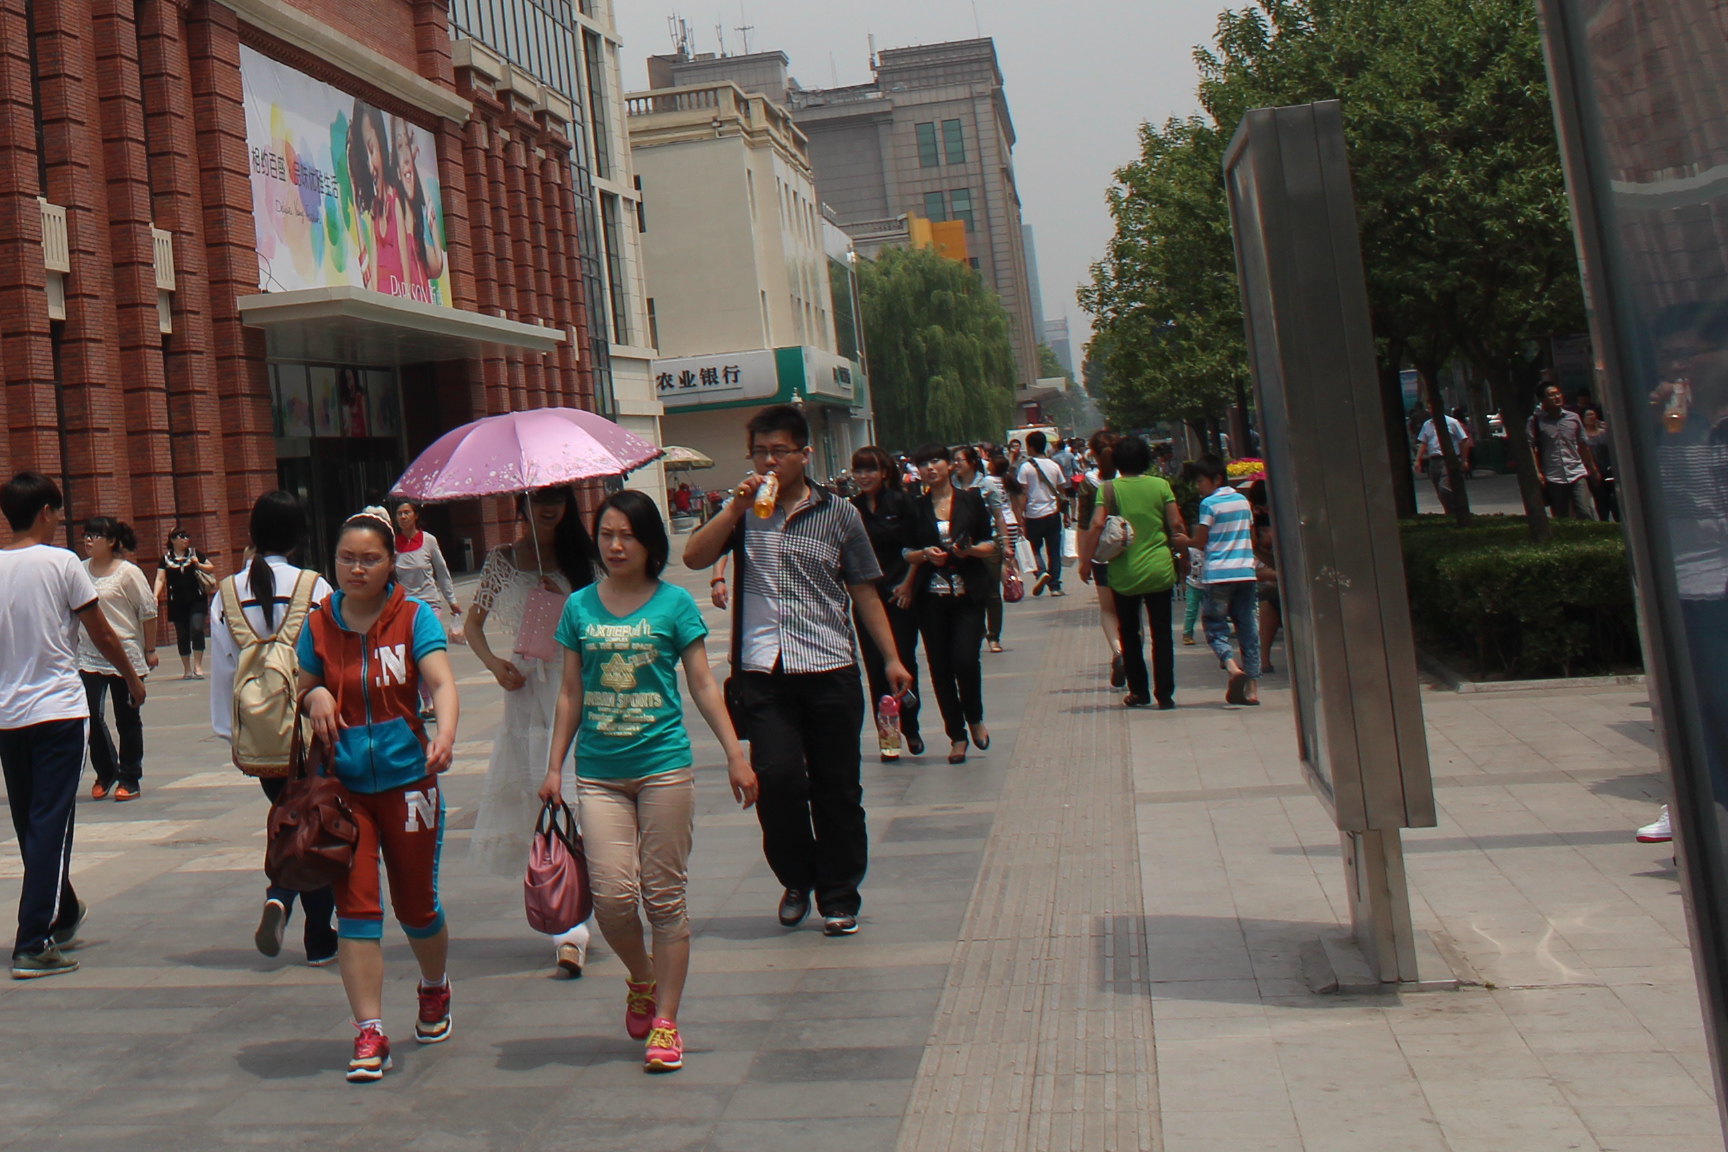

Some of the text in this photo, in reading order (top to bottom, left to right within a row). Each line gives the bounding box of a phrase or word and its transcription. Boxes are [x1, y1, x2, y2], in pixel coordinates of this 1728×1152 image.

[656, 365, 741, 391] 农业银行
[375, 644, 407, 687] N
[405, 787, 438, 832] N
